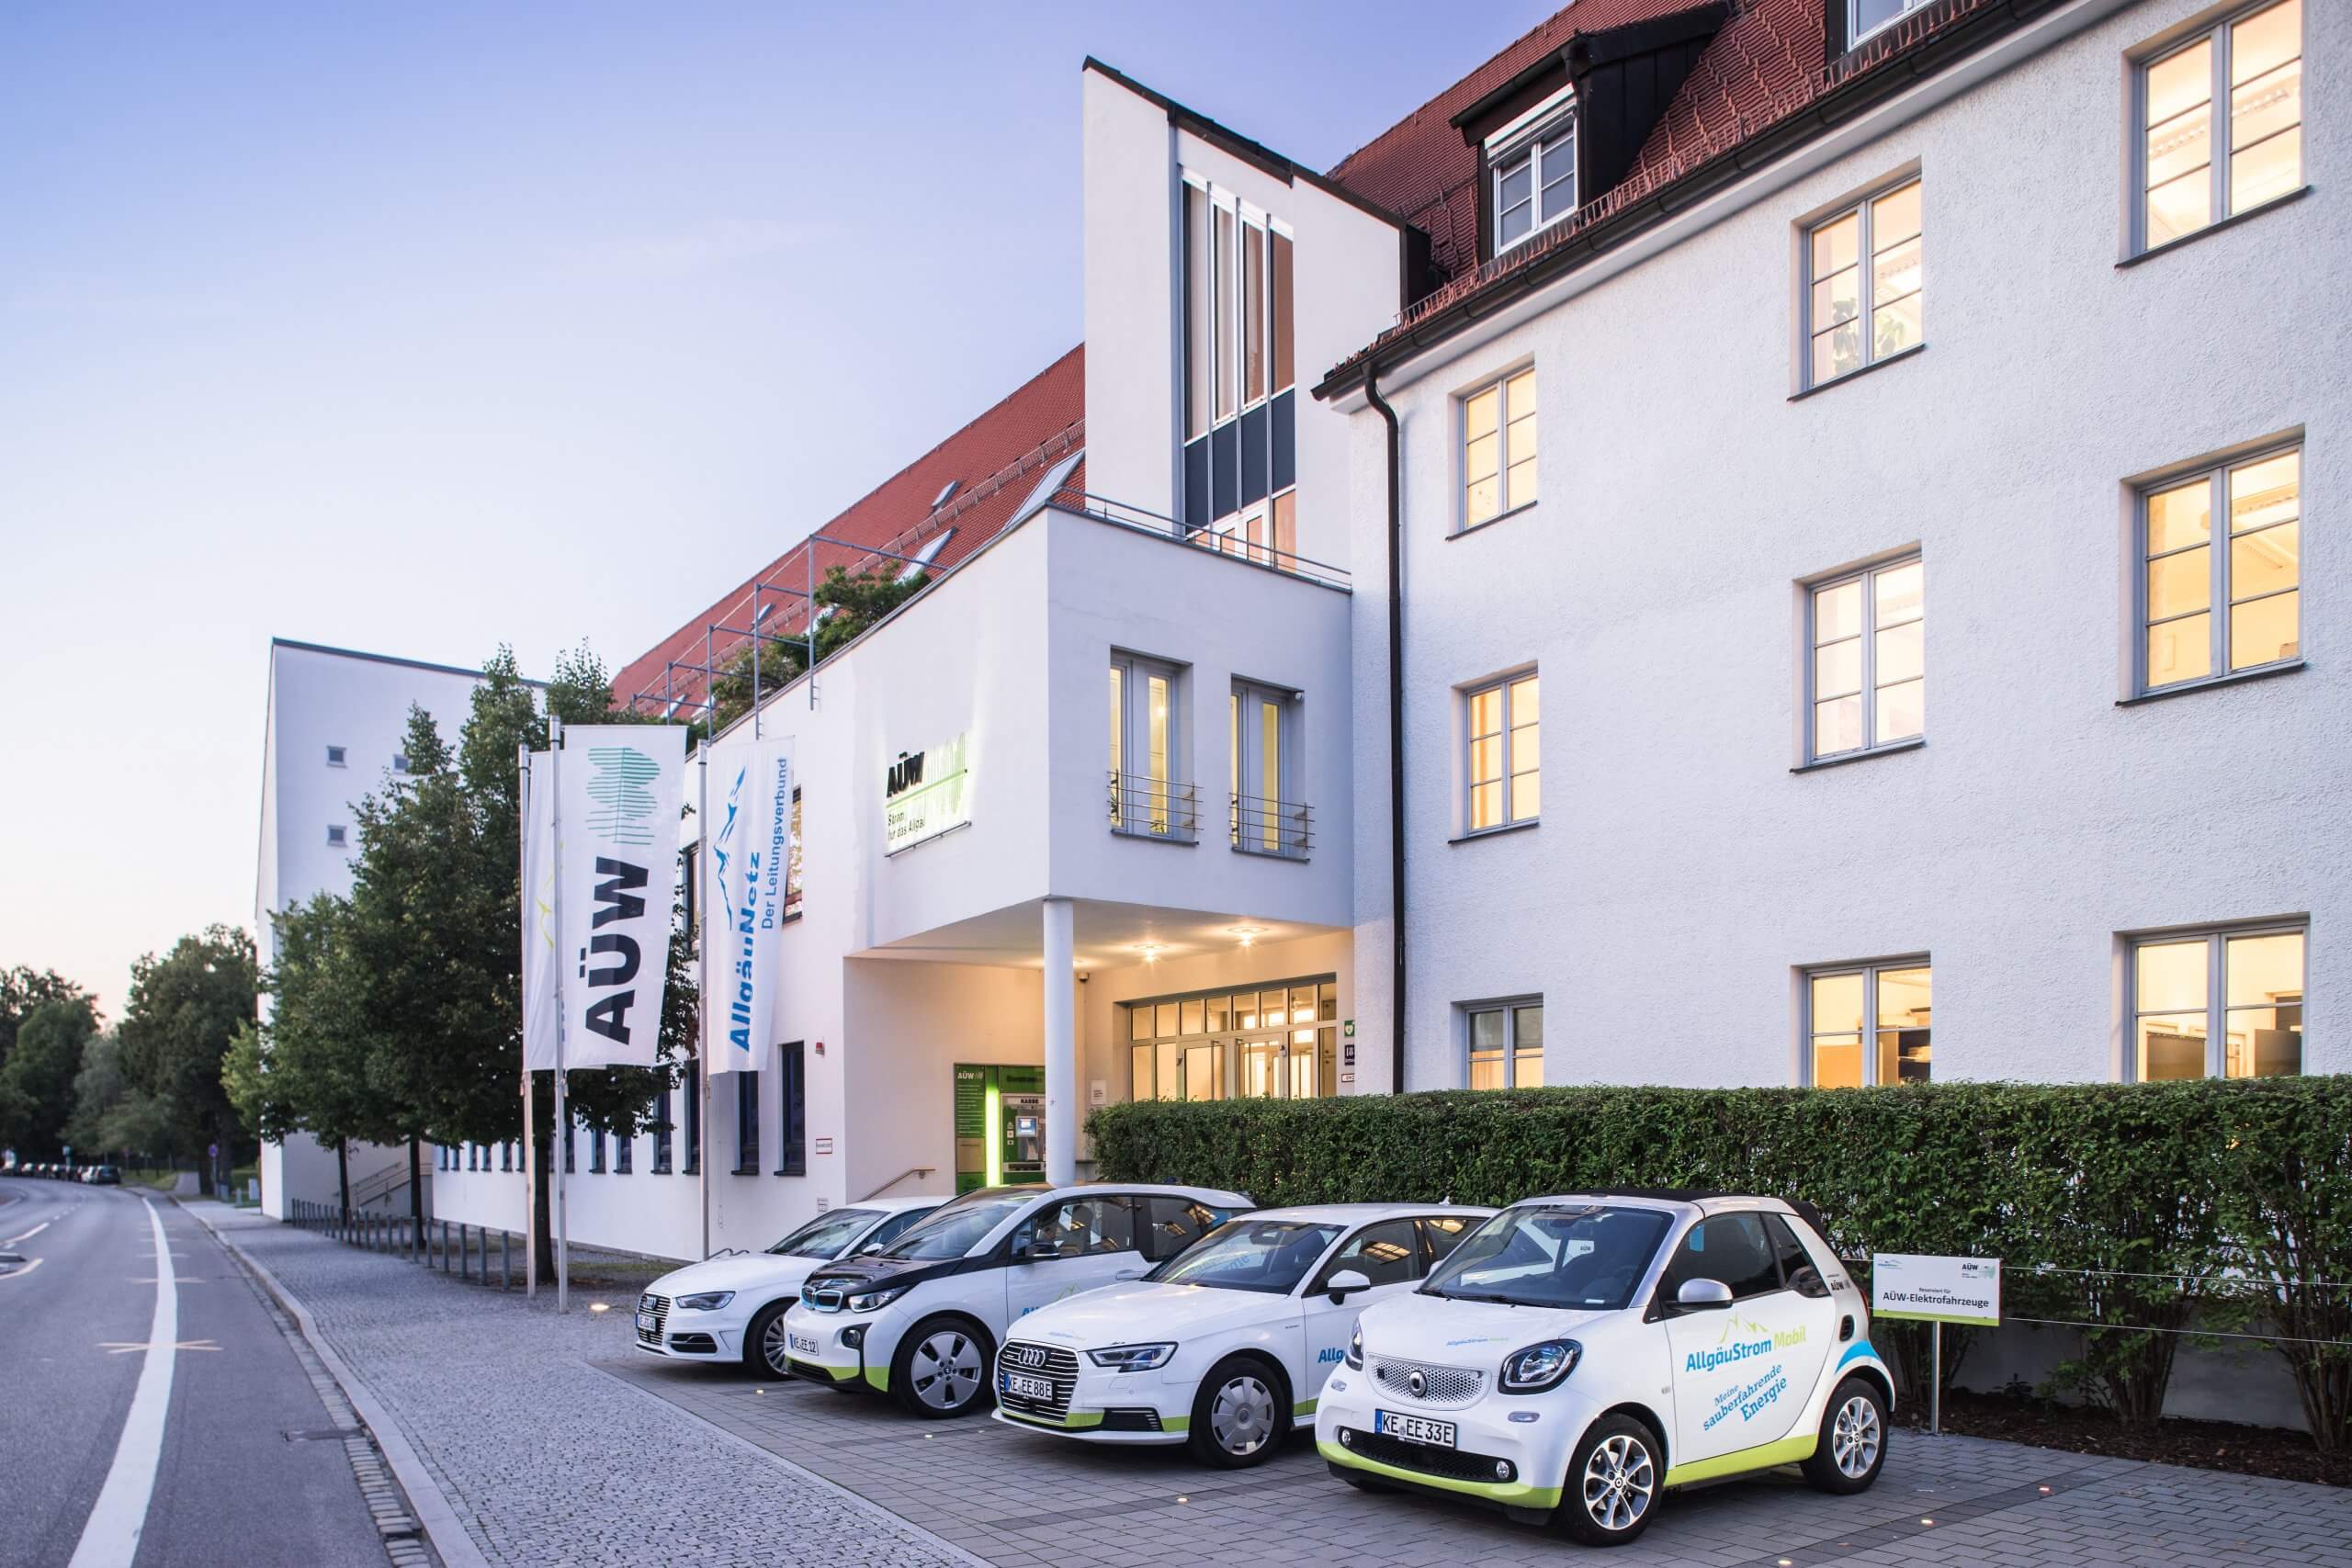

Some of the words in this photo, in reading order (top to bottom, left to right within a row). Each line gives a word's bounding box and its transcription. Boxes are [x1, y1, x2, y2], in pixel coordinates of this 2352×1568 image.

[887, 751, 924, 798] AÜW
[768, 757, 786, 897] Leitungsverbund
[762, 900, 775, 930] Der
[580, 856, 649, 1045] AÜW
[729, 852, 760, 1053] AllgäuNetz
[957, 1070, 974, 1079] AÜW
[1883, 1291, 1989, 1308] AÜW-Elektrofahrzeuge
[1686, 1339, 1771, 1372] AllgäuStrom
[1774, 1325, 1806, 1349] Mobil
[1703, 1364, 1782, 1431] sauberfahrende
[1714, 1384, 1739, 1406] Meine
[1740, 1378, 1787, 1422] Energie
[1382, 1413, 1398, 1434] KE
